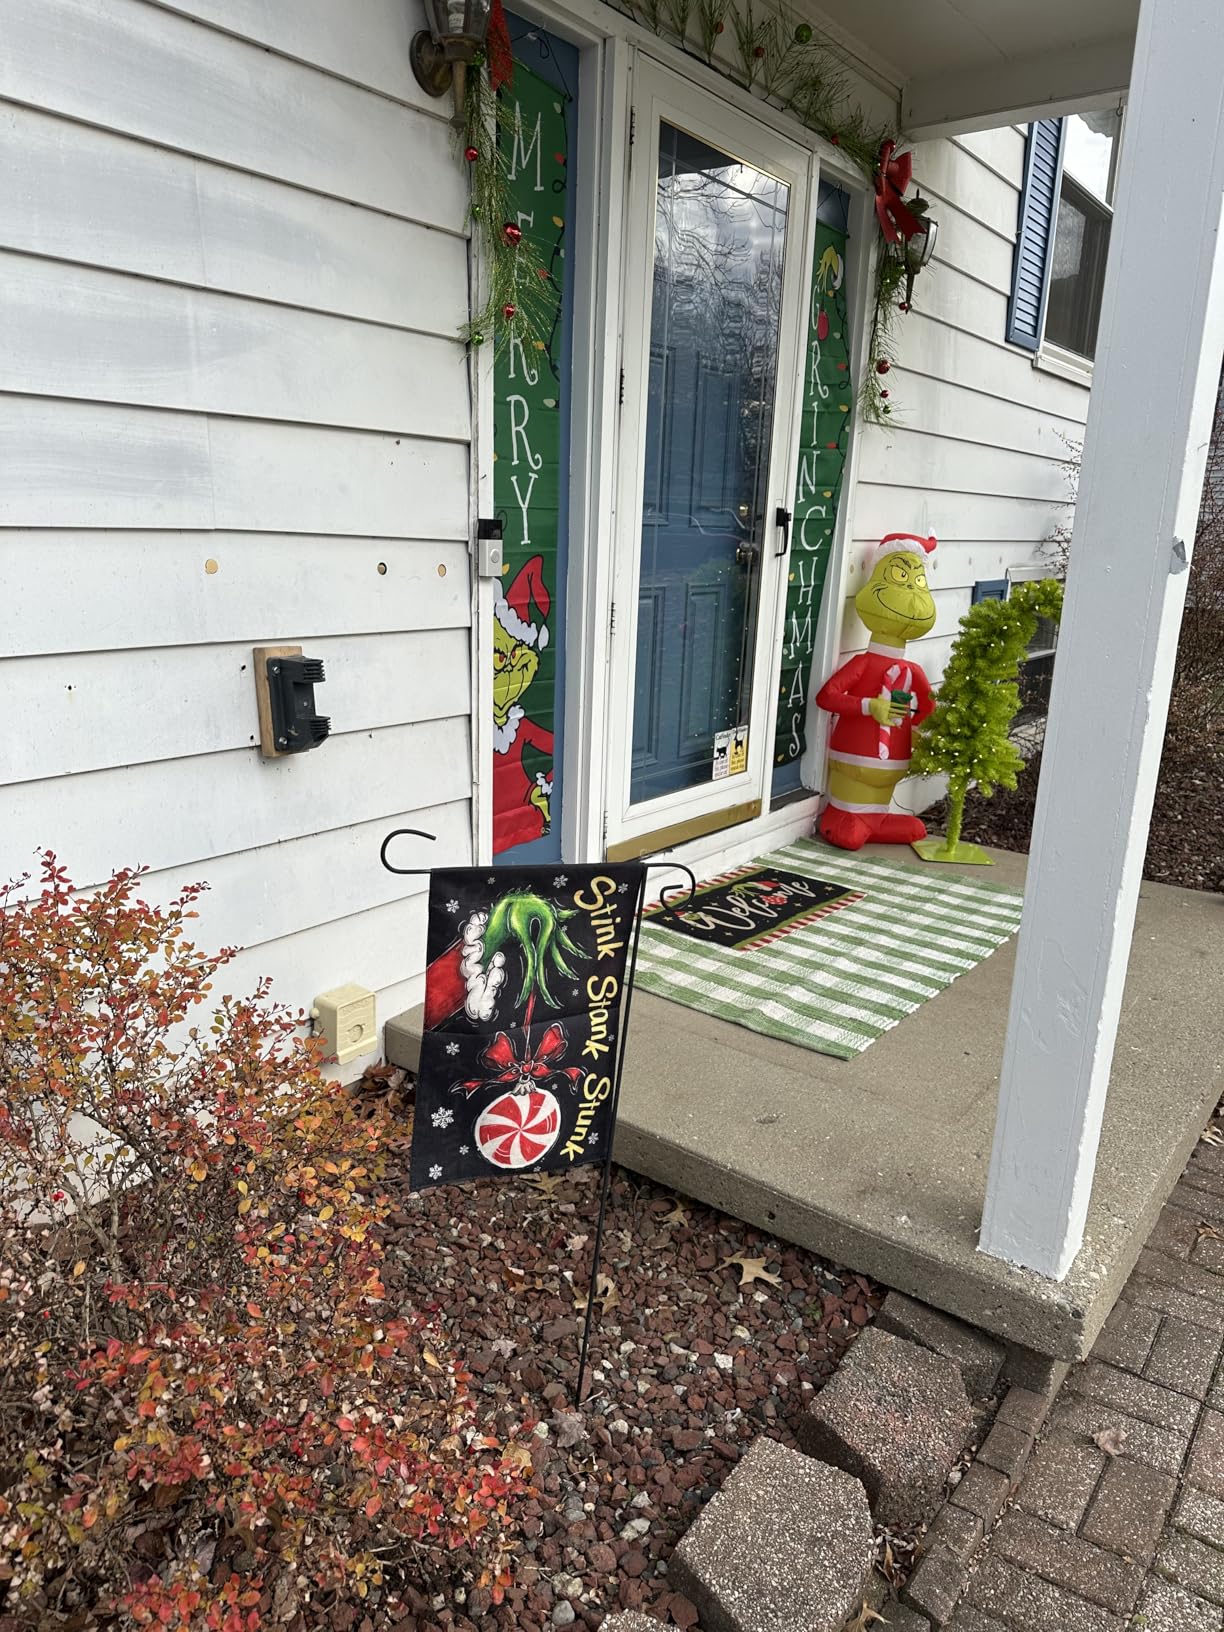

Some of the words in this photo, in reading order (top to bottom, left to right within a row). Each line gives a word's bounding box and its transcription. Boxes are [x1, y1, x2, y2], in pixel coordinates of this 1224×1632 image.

[787, 284, 829, 758] GRINCHMAS
[573, 875, 624, 961] Stink
[581, 975, 618, 1060] Stank
[559, 1072, 611, 1162] Stunk
